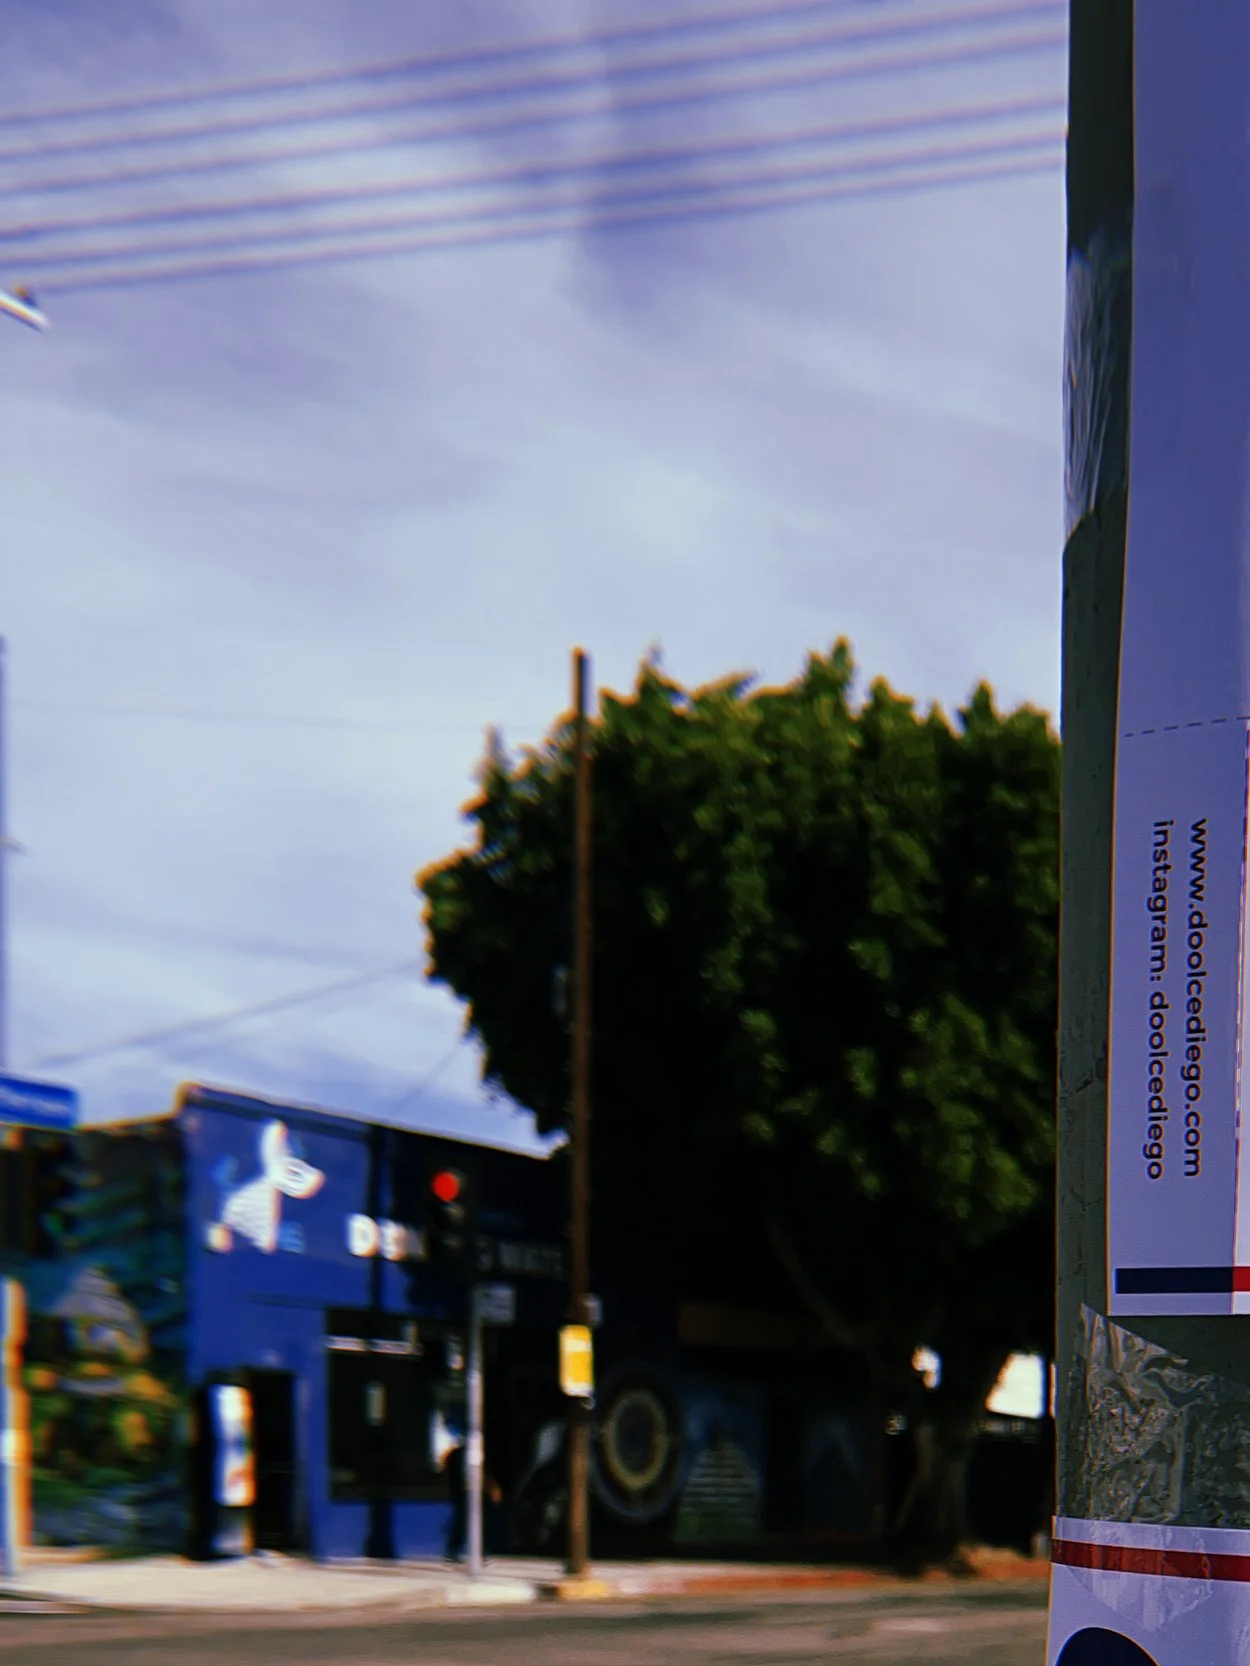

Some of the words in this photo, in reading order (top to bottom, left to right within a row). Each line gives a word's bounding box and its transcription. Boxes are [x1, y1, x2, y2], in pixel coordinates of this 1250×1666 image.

[1146, 819, 1175, 982] instagram:
[1142, 991, 1170, 1180] doolcediego
[1180, 817, 1209, 1177] www.doolcediego.com
